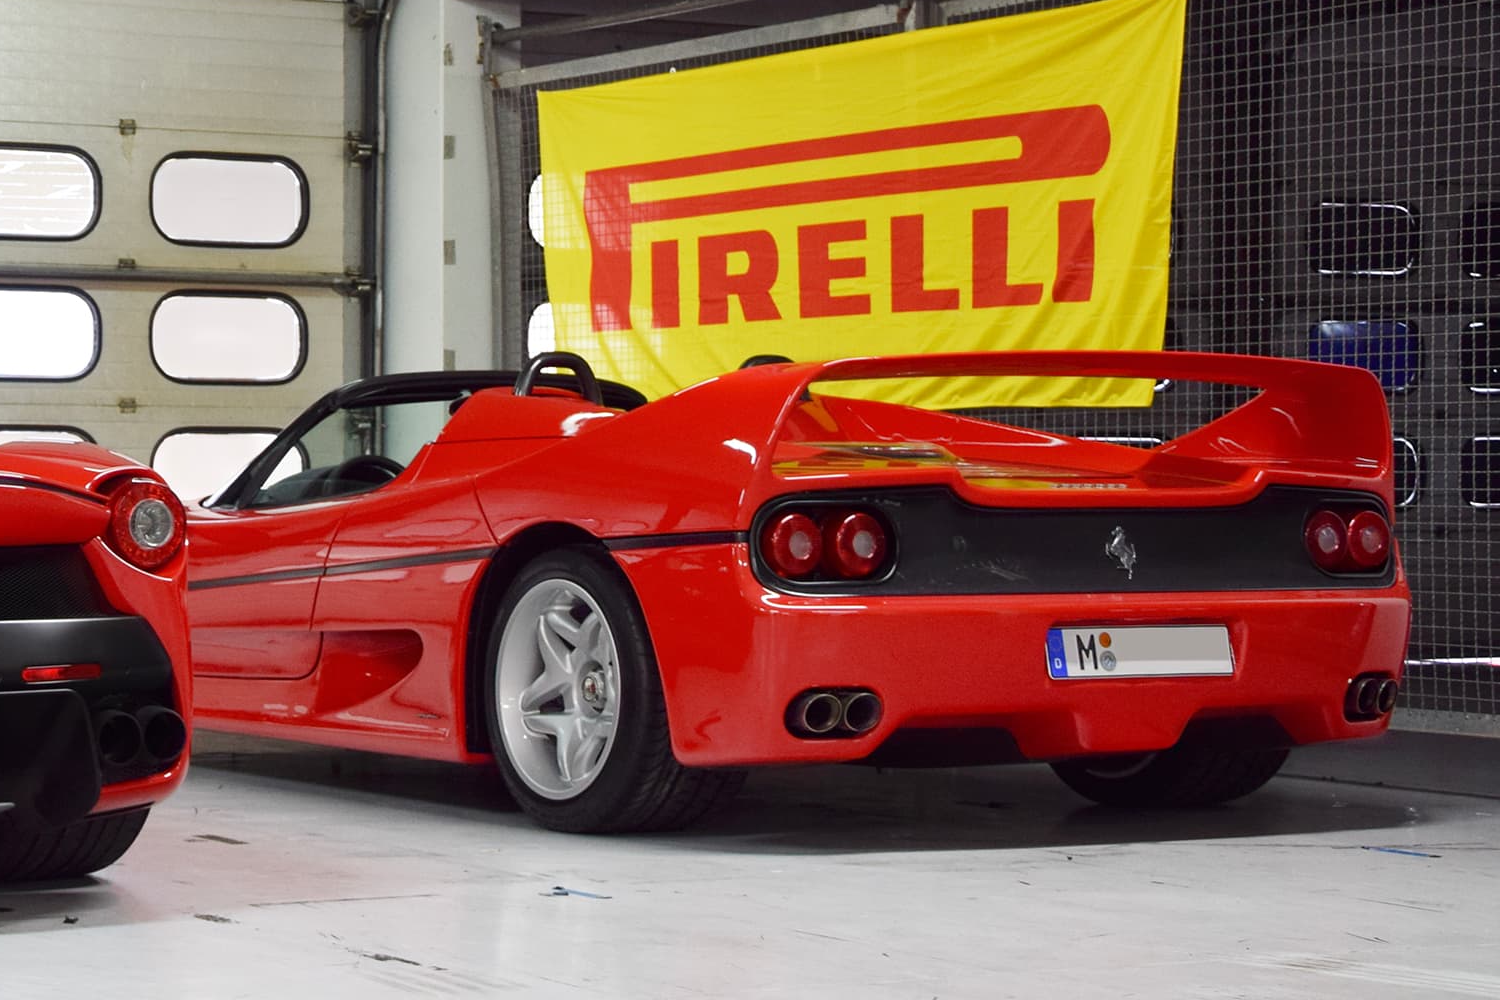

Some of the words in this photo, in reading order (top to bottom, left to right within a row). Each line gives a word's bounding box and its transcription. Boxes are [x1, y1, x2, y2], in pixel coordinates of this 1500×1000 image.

[584, 104, 1111, 332] PIRELLI
[1055, 658, 1063, 668] D
[1077, 634, 1098, 670] M
